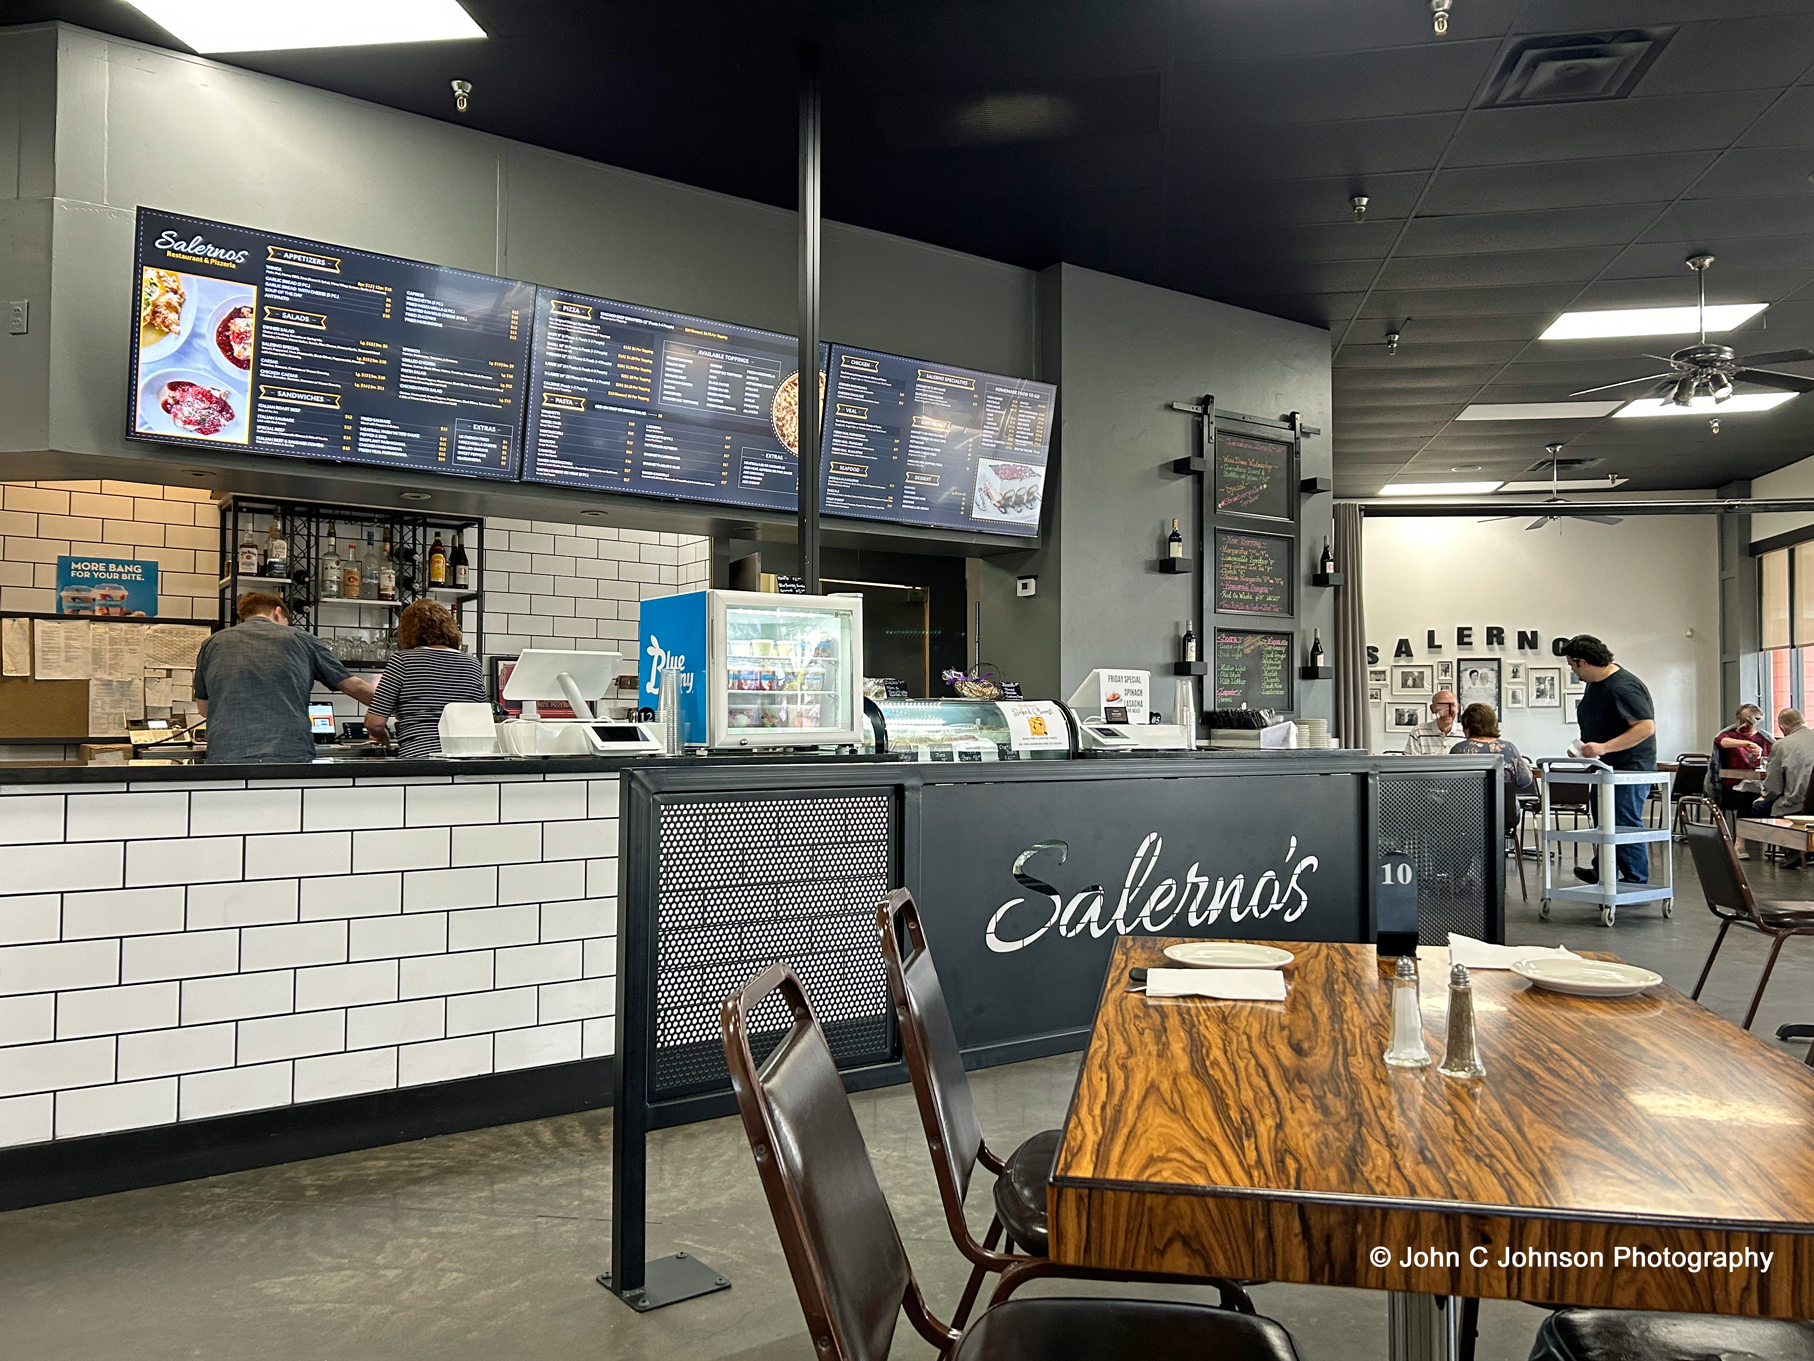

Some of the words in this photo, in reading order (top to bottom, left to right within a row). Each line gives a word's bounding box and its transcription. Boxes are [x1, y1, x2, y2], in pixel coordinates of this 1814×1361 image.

[155, 230, 248, 264] Salernos
[166, 250, 202, 263] Restaurant
[210, 258, 236, 269] Pizzeria
[283, 252, 325, 266] APPETIZERS
[562, 305, 580, 313] PIZZA
[281, 312, 309, 322] SALADS
[697, 349, 724, 359] AVAILABLE
[724, 354, 748, 364] TOPPINGS
[850, 359, 870, 367] CHICKEN
[926, 373, 944, 381] SALERNO
[944, 376, 968, 385] SPECIALTIES
[276, 390, 324, 402] SANDWICHES
[555, 397, 573, 405] PASTA
[472, 423, 496, 432] EXTRAS
[71, 561, 106, 572] MORE
[108, 563, 142, 573] BANG
[71, 570, 91, 579] FOR
[92, 571, 119, 580] YOUR
[121, 572, 145, 581] BITE.
[1108, 675, 1124, 683] FRIDAY
[1124, 676, 1142, 684] SPECIAL
[1124, 688, 1143, 697] SPINACH
[1124, 699, 1143, 708] LASAGNA
[640, 712, 654, 722] 12
[1151, 716, 1161, 724] 05
[1381, 862, 1413, 886] 10
[985, 832, 1319, 953] Salerno's
